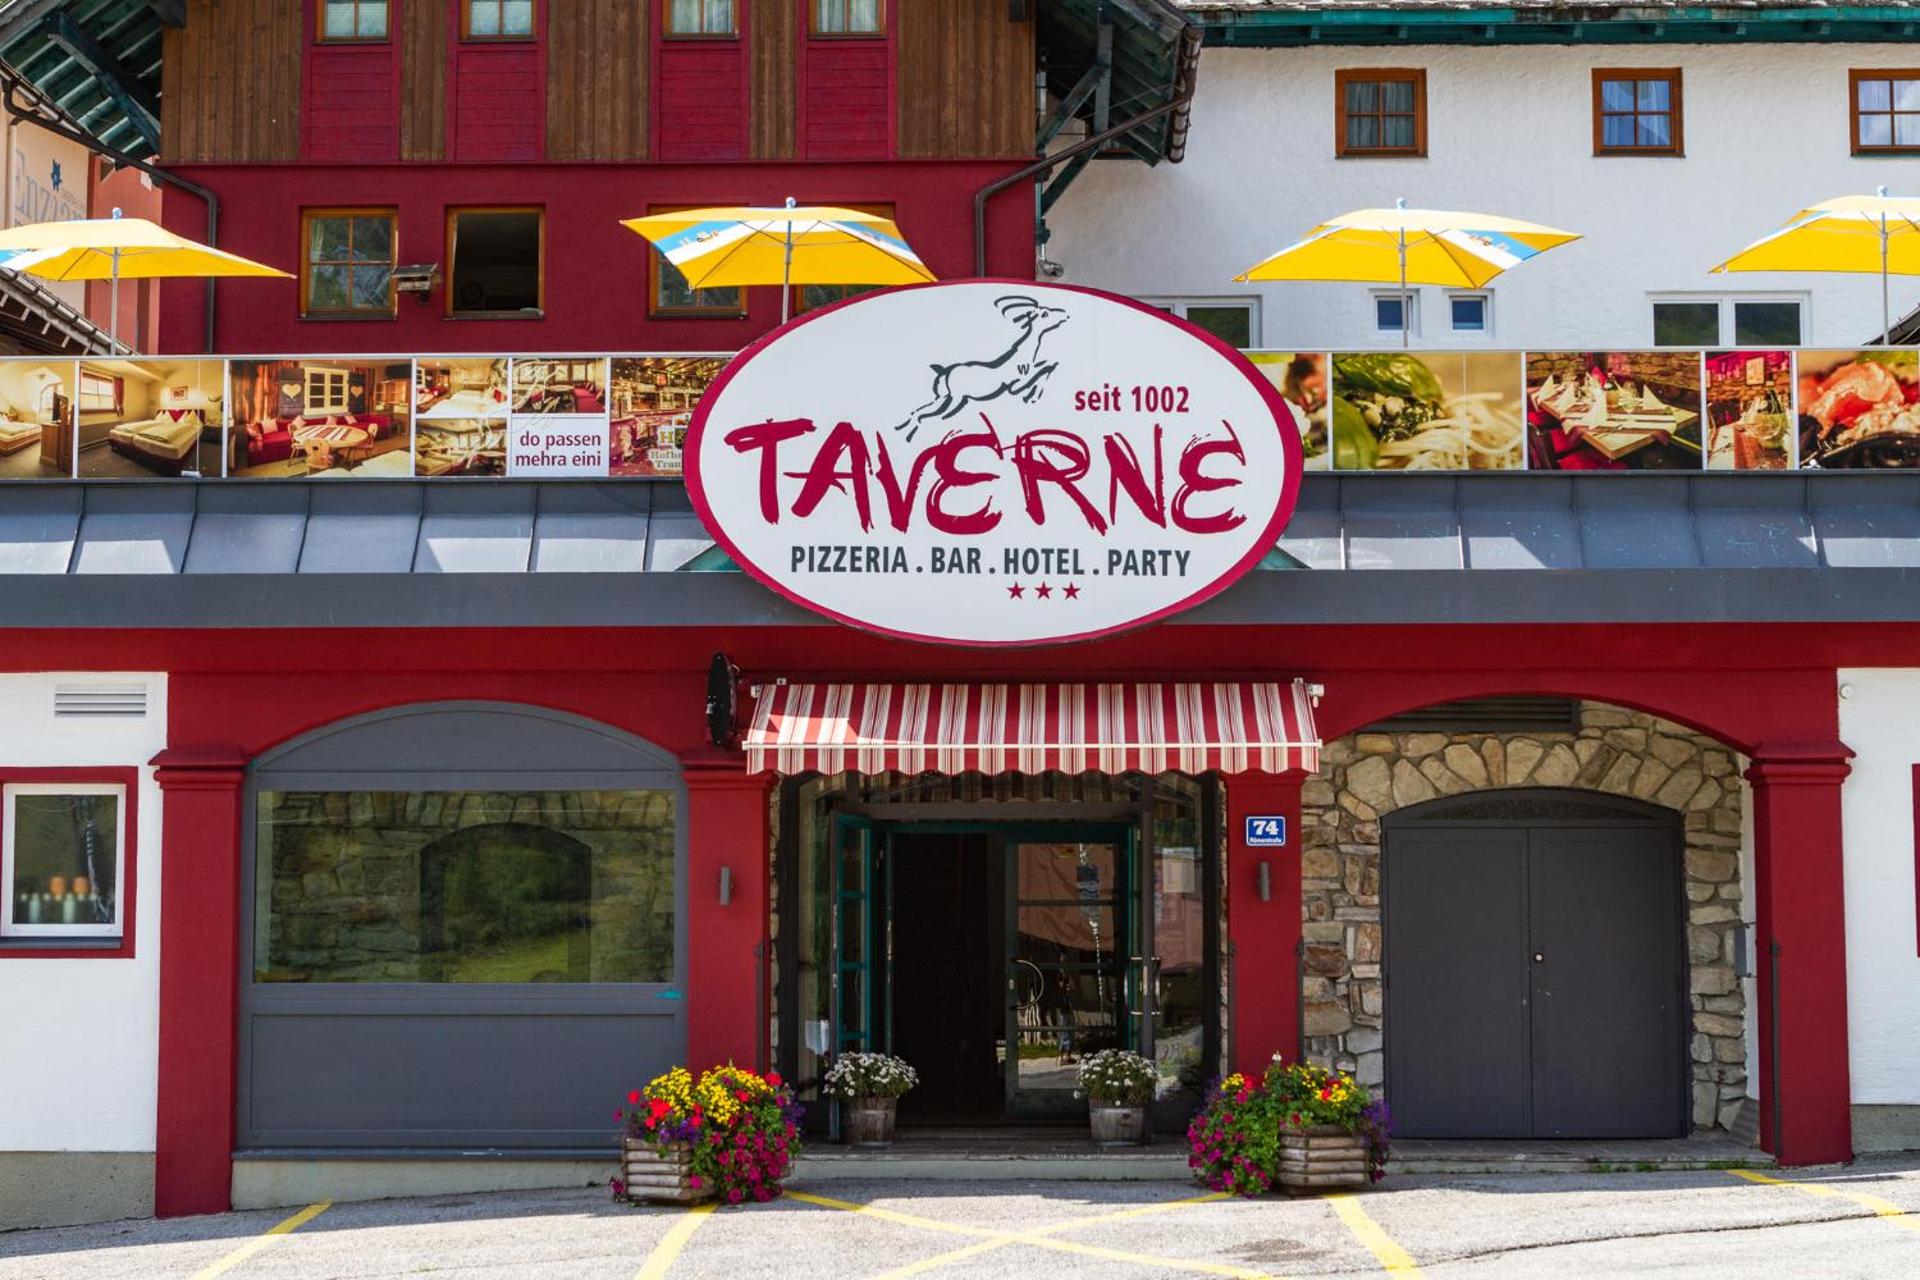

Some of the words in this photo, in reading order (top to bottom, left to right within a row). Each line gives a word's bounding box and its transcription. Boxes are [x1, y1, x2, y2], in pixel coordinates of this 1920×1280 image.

[1074, 383, 1121, 412] seit
[1132, 385, 1190, 413] 1002
[519, 430, 540, 447] do
[545, 434, 602, 450] passen
[515, 450, 567, 467] mehra
[572, 450, 601, 467] eini
[724, 412, 1246, 537] TAVERNE
[791, 545, 909, 573] PIZZERIA
[931, 546, 982, 574] BAR
[1004, 547, 1085, 576] HOTEL
[1107, 549, 1191, 577] PARTY
[1253, 820, 1279, 836] 74
